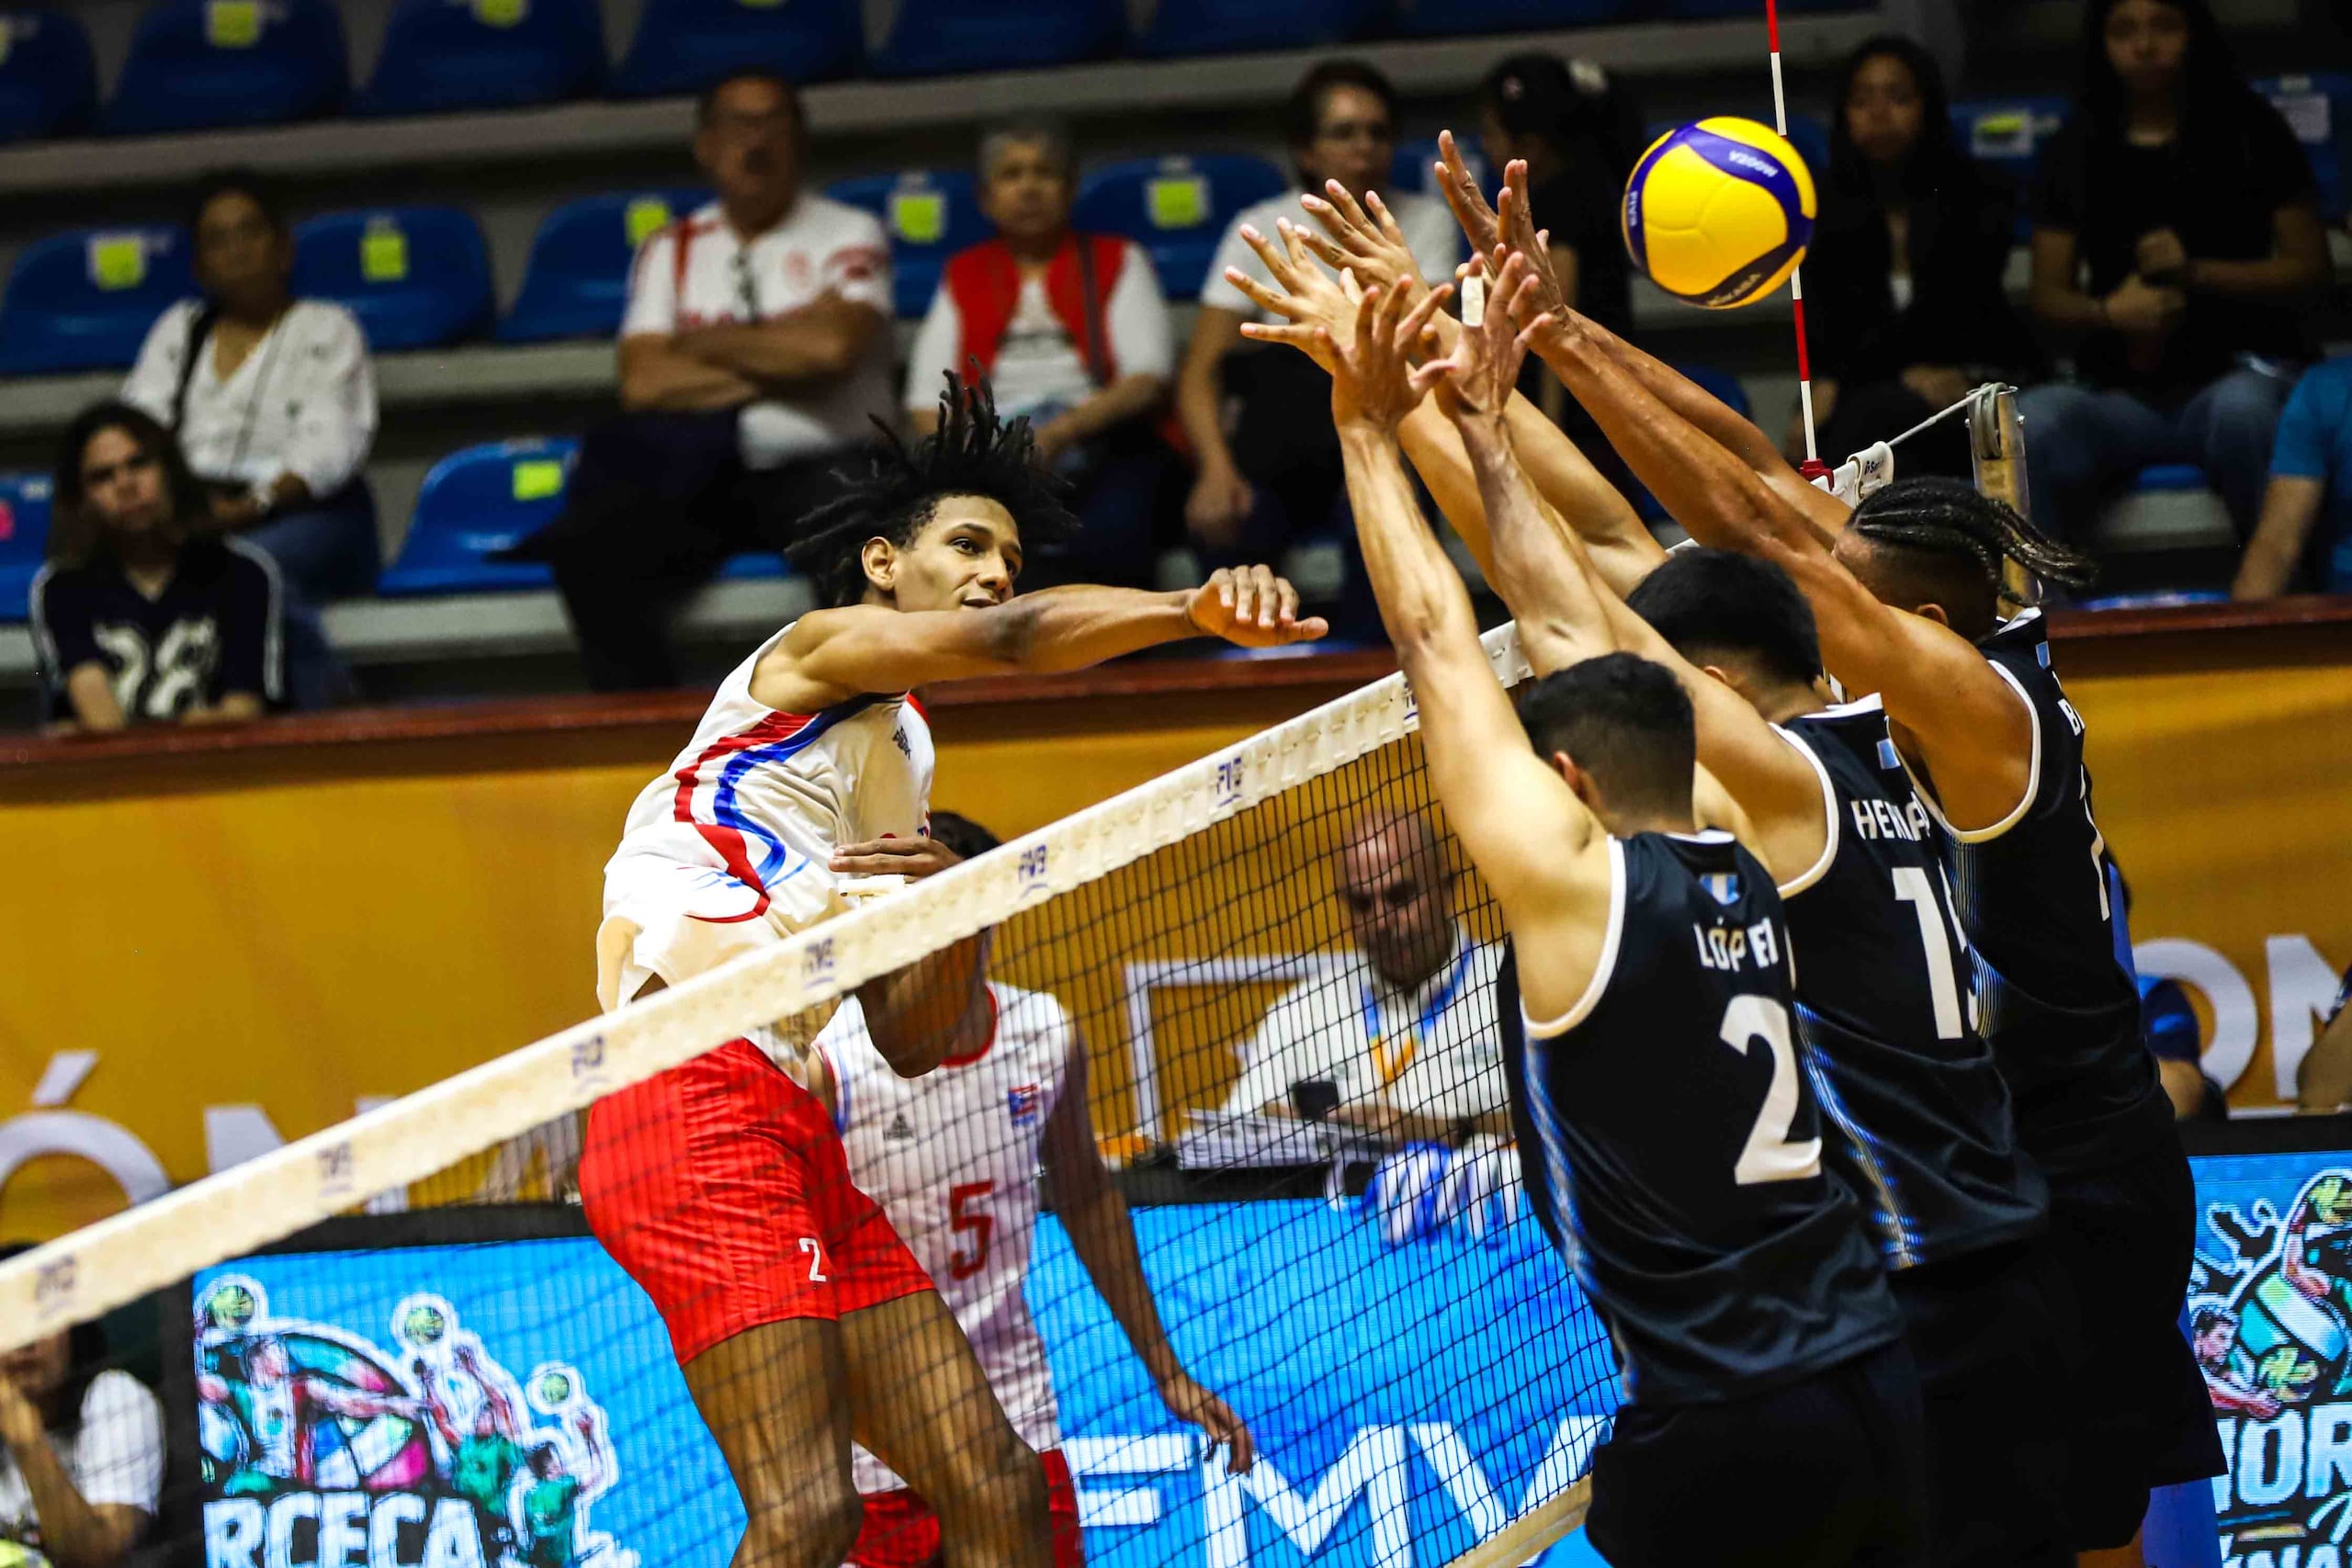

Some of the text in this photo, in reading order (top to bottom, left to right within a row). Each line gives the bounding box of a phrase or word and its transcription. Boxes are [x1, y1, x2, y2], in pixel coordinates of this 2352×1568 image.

[1719, 993, 1823, 1185] 2
[798, 1237, 827, 1282] 2
[950, 1180, 995, 1280] 5
